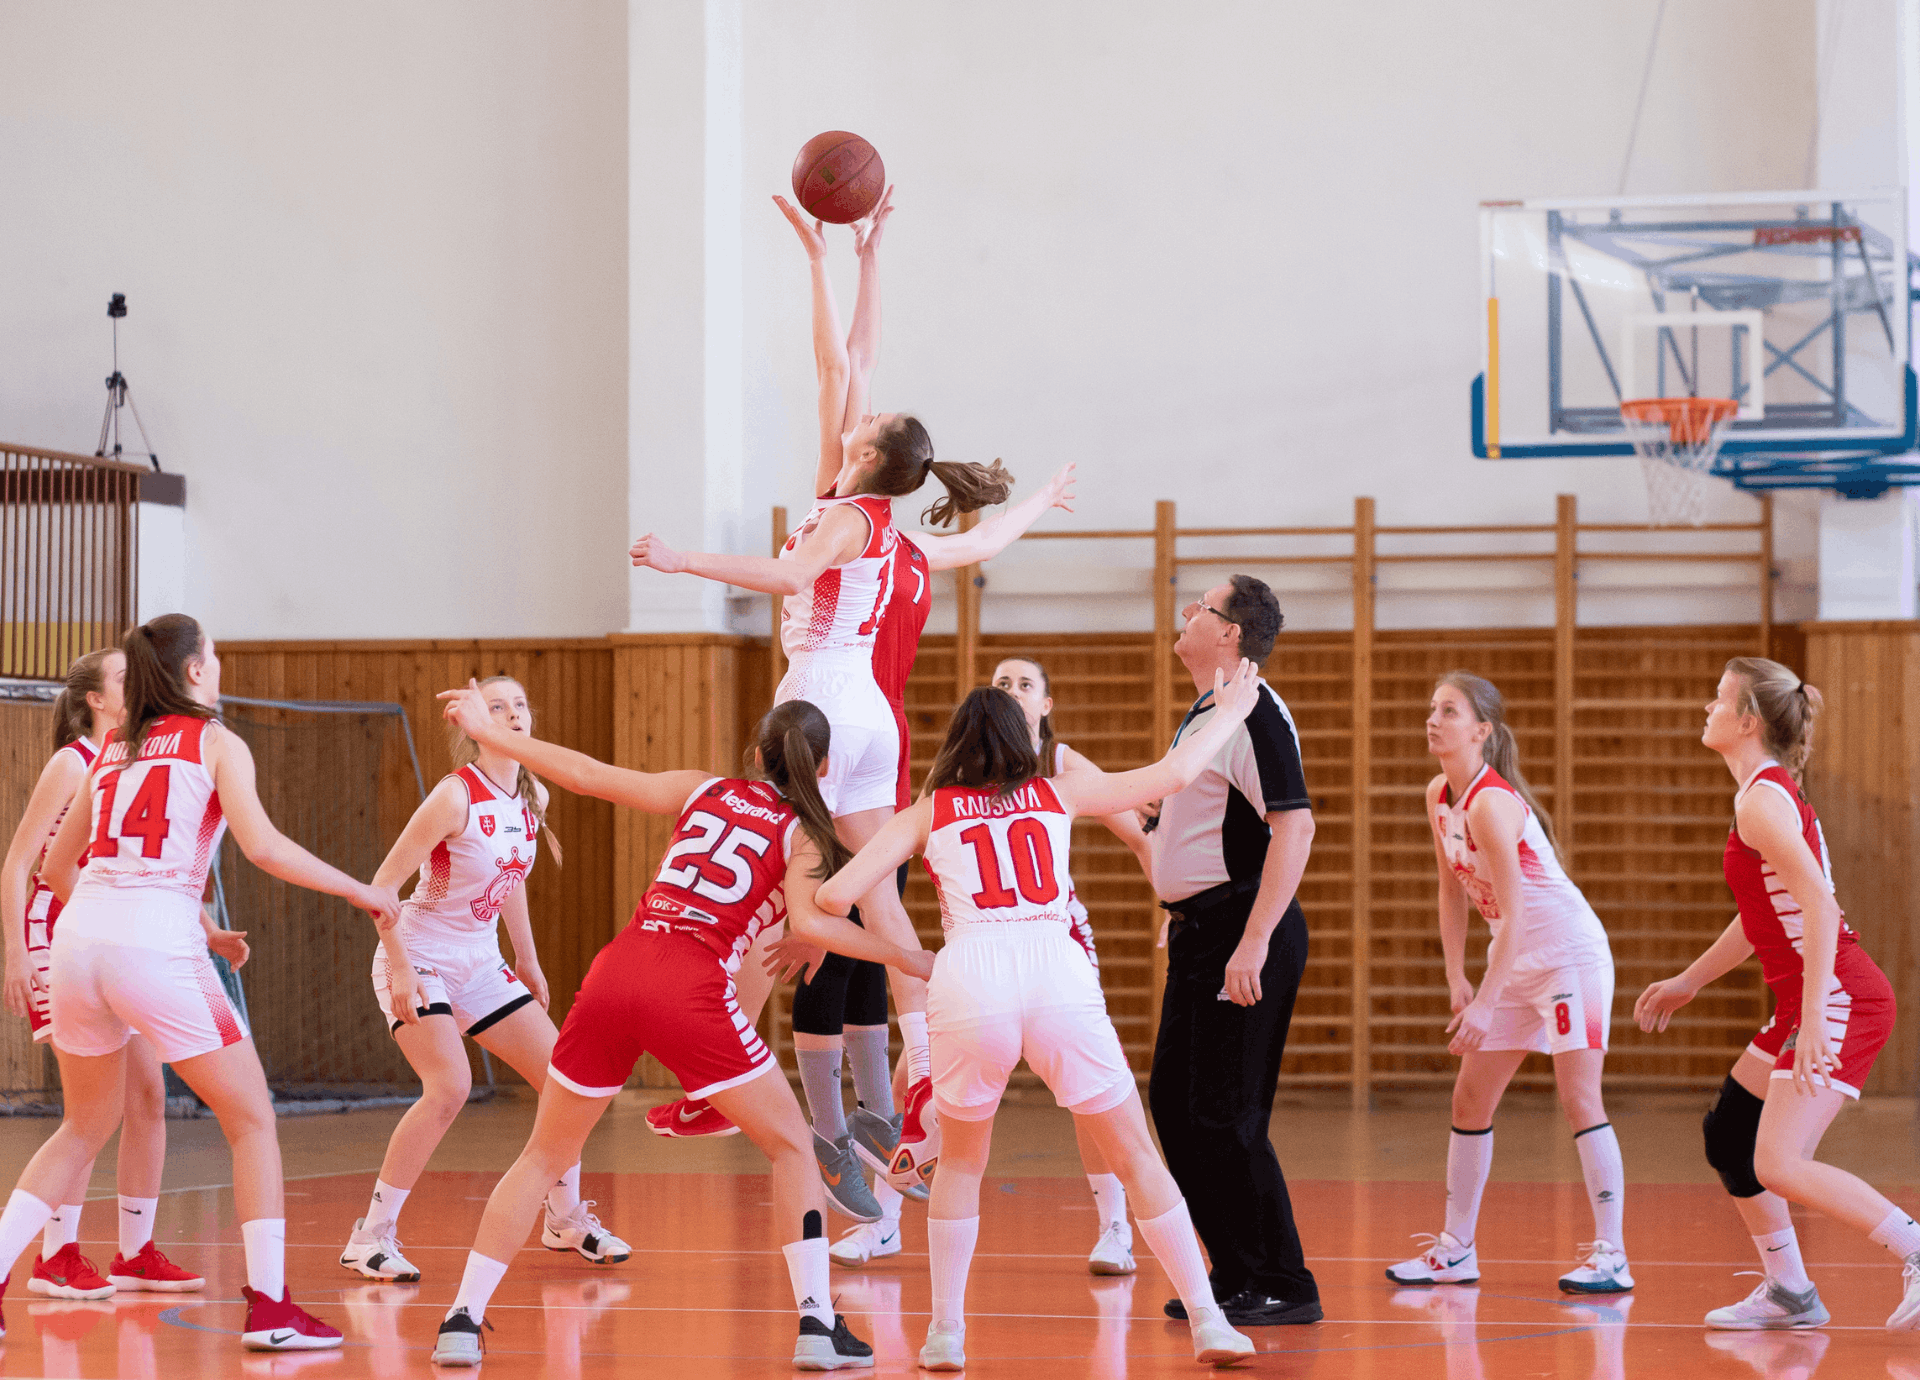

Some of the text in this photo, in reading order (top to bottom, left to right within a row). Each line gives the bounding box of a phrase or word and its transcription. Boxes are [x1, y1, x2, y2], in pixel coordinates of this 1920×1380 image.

[91, 764, 172, 860] 14
[720, 789, 787, 825] legrand
[655, 809, 772, 905] 25
[960, 816, 1060, 911] 10
[1555, 1002, 1572, 1036] 8
